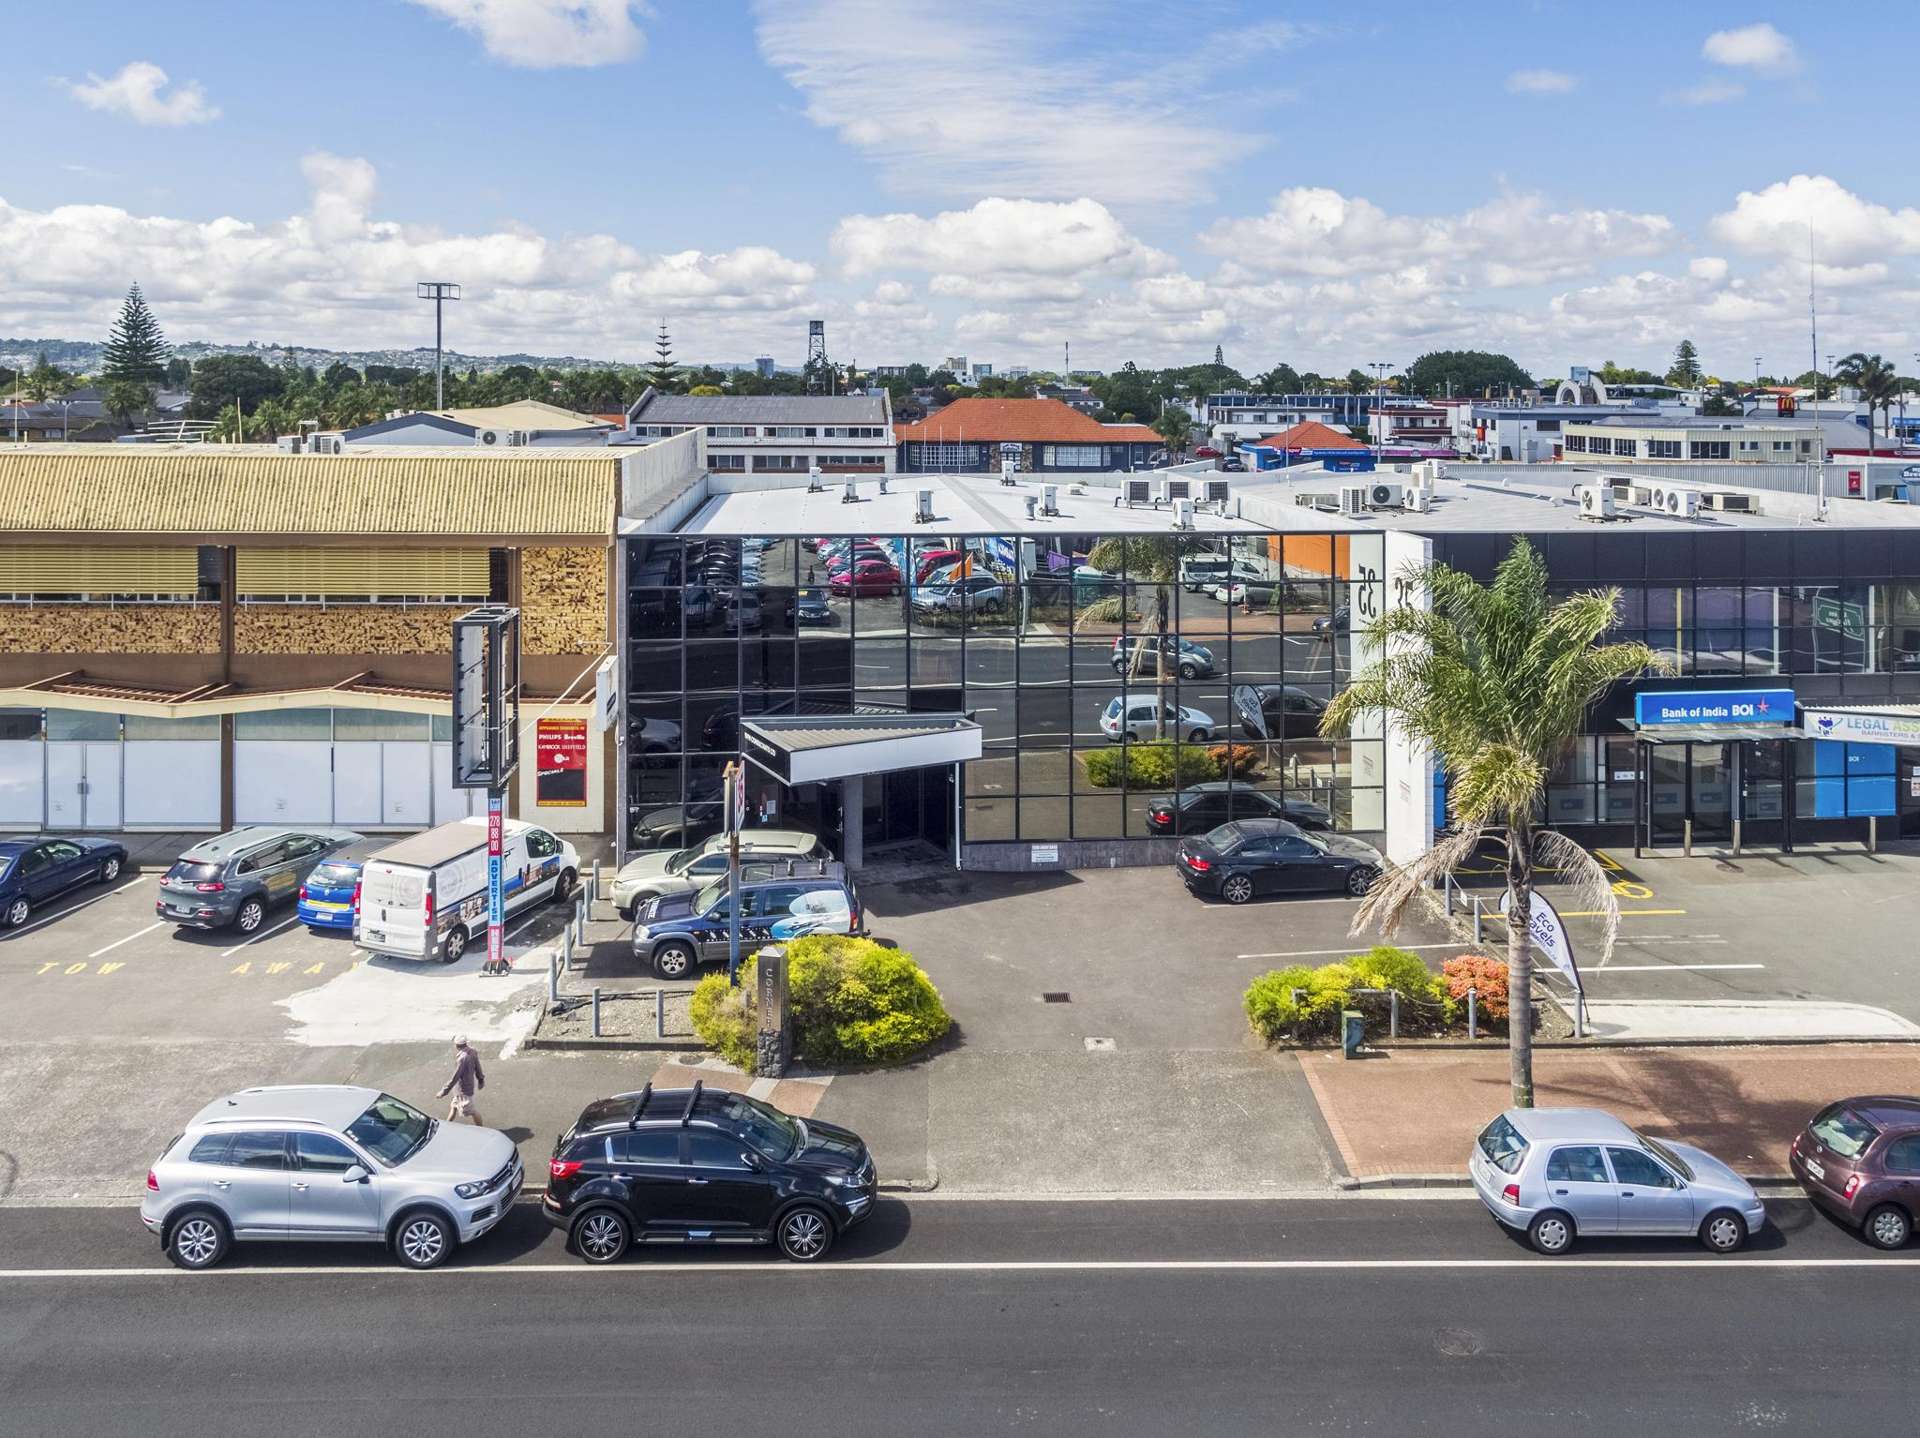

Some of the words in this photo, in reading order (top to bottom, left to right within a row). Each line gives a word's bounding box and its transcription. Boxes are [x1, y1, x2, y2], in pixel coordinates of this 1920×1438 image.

[1662, 707, 1688, 718] Bank
[1689, 706, 1700, 717] of
[1702, 706, 1728, 717] India
[1732, 704, 1754, 716] BOI
[1847, 717, 1889, 731] LEGAL
[489, 815, 500, 827] 278
[490, 840, 499, 851] 00
[490, 859, 498, 921] ADVERTISE
[1535, 912, 1555, 933] Eco
[1529, 920, 1556, 947] avels
[36, 962, 126, 975] TOW
